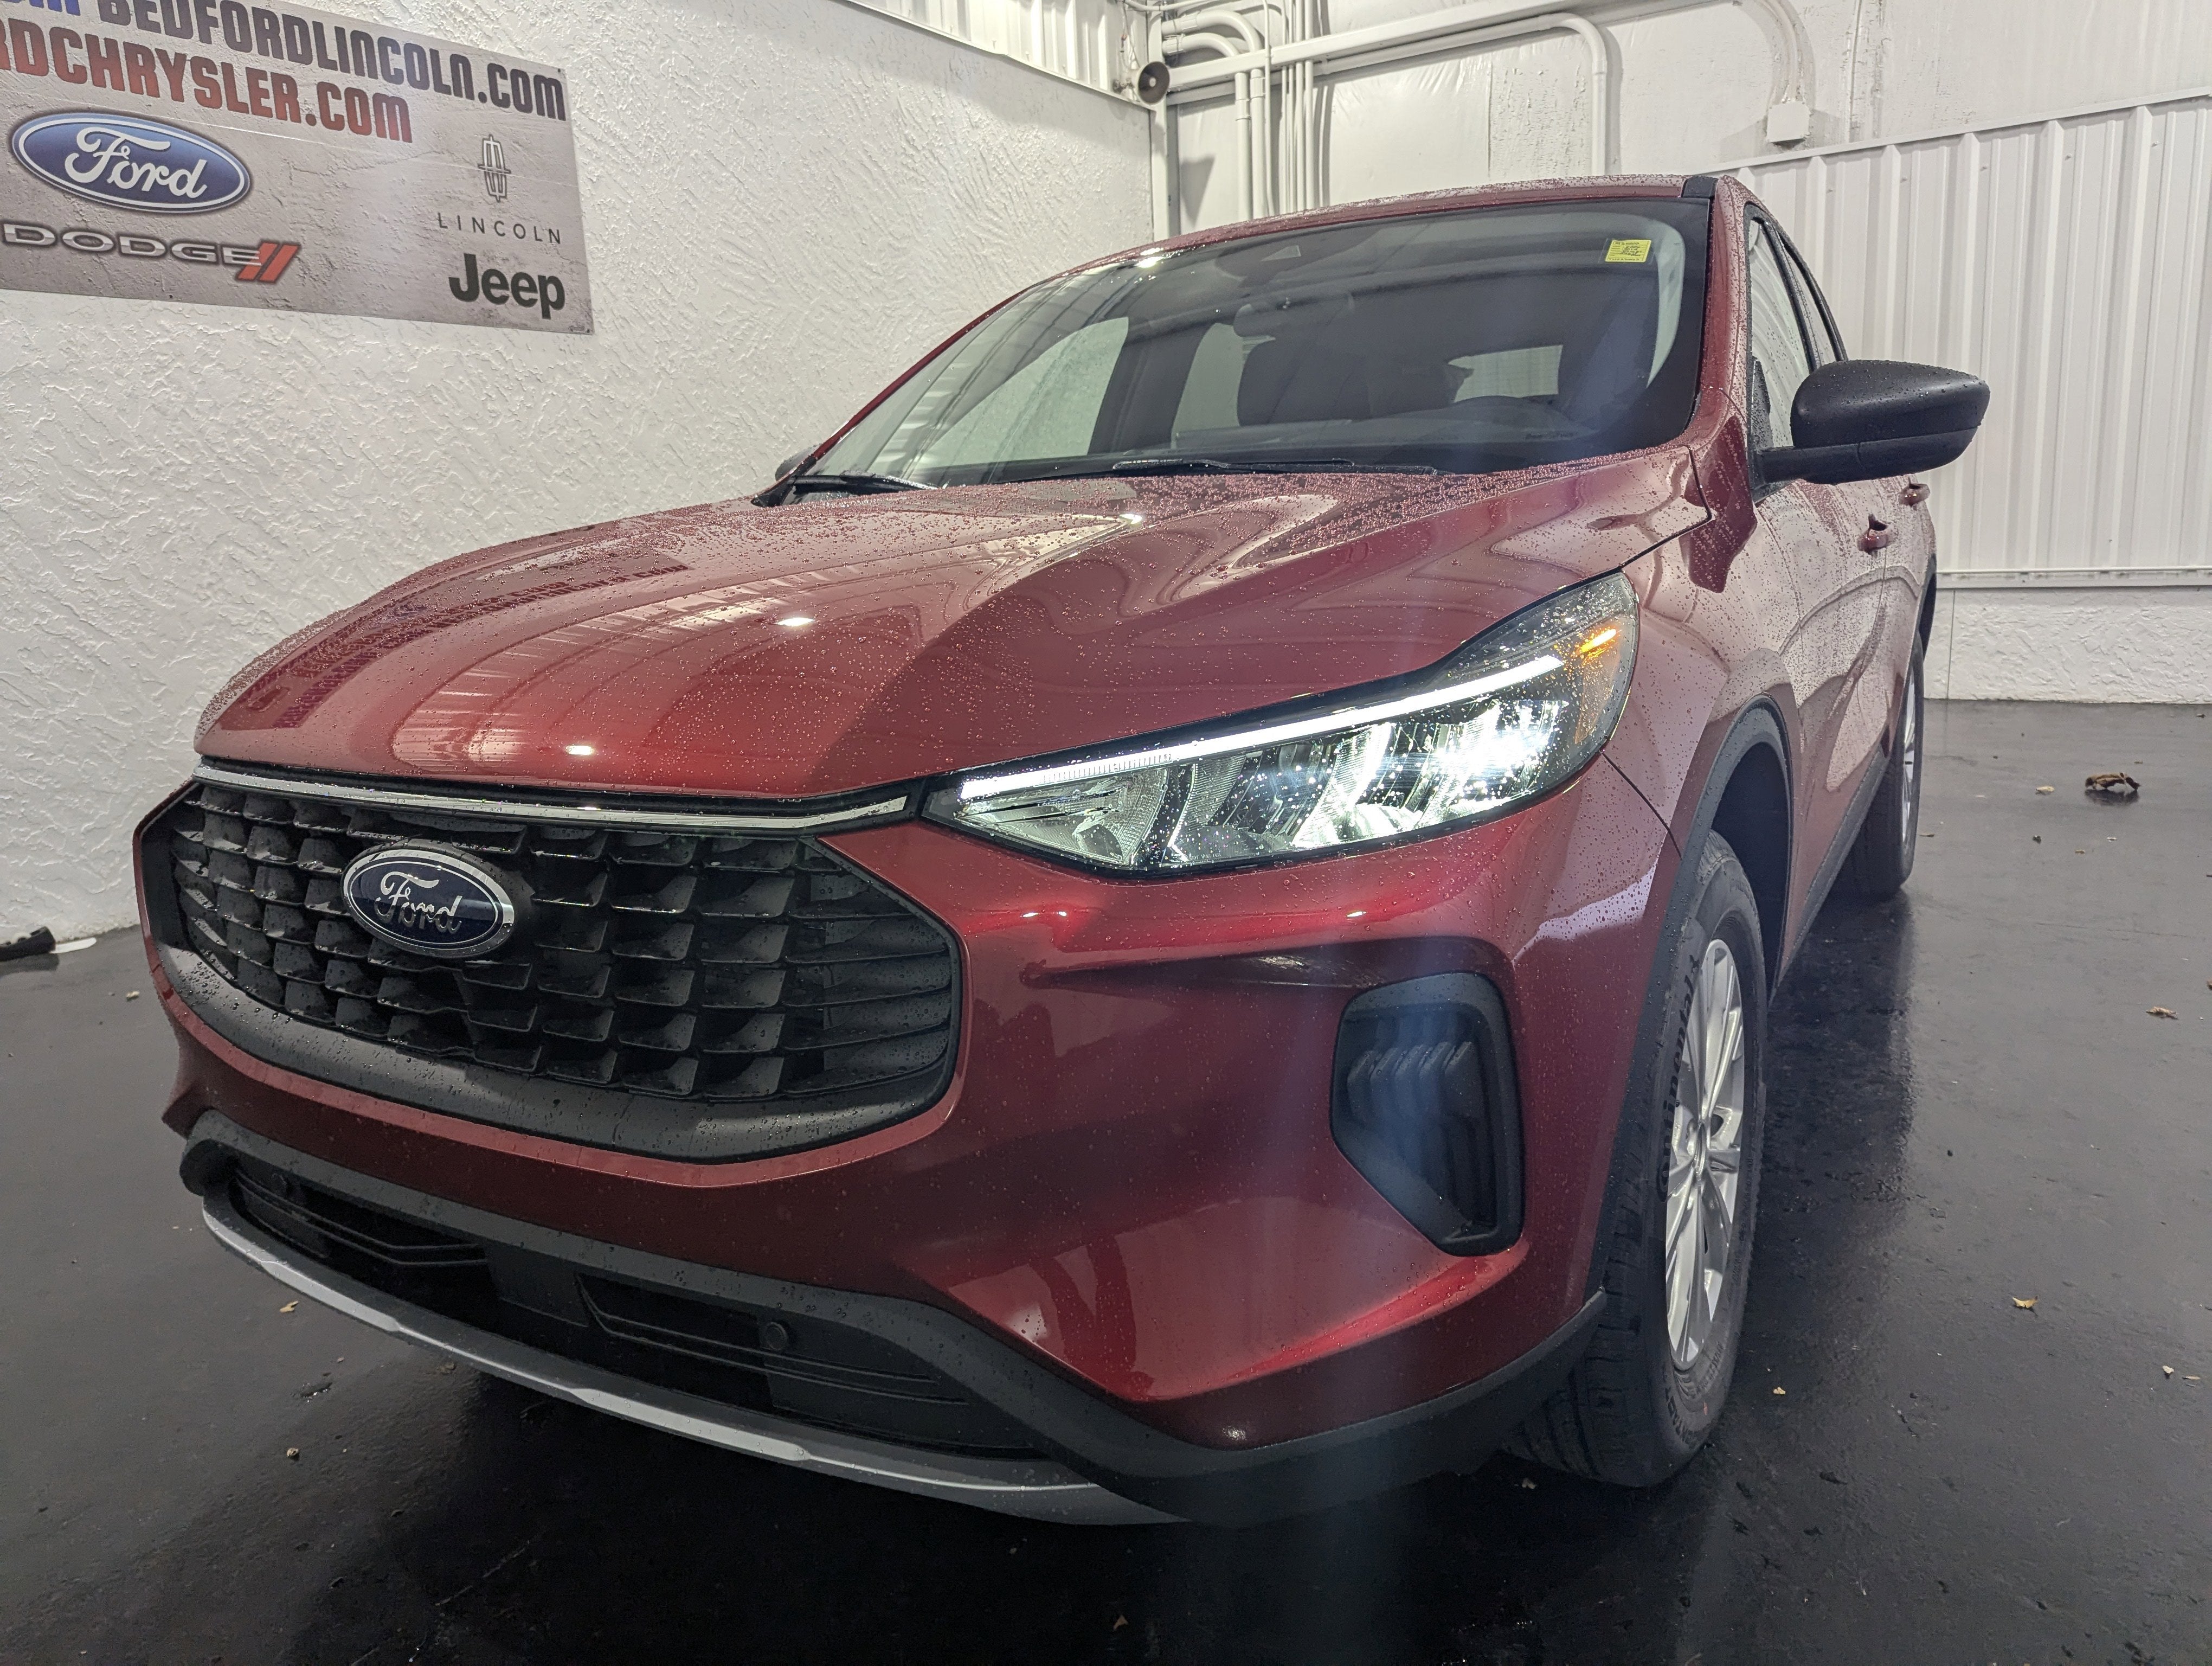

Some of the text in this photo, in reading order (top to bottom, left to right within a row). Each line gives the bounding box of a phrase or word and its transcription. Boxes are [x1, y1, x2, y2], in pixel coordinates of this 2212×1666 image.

[65, 127, 208, 198] Ford
[3, 223, 262, 266] DODGE
[438, 212, 561, 244] LINCOLN
[448, 253, 565, 319] Jeep
[375, 871, 462, 933] Ford
